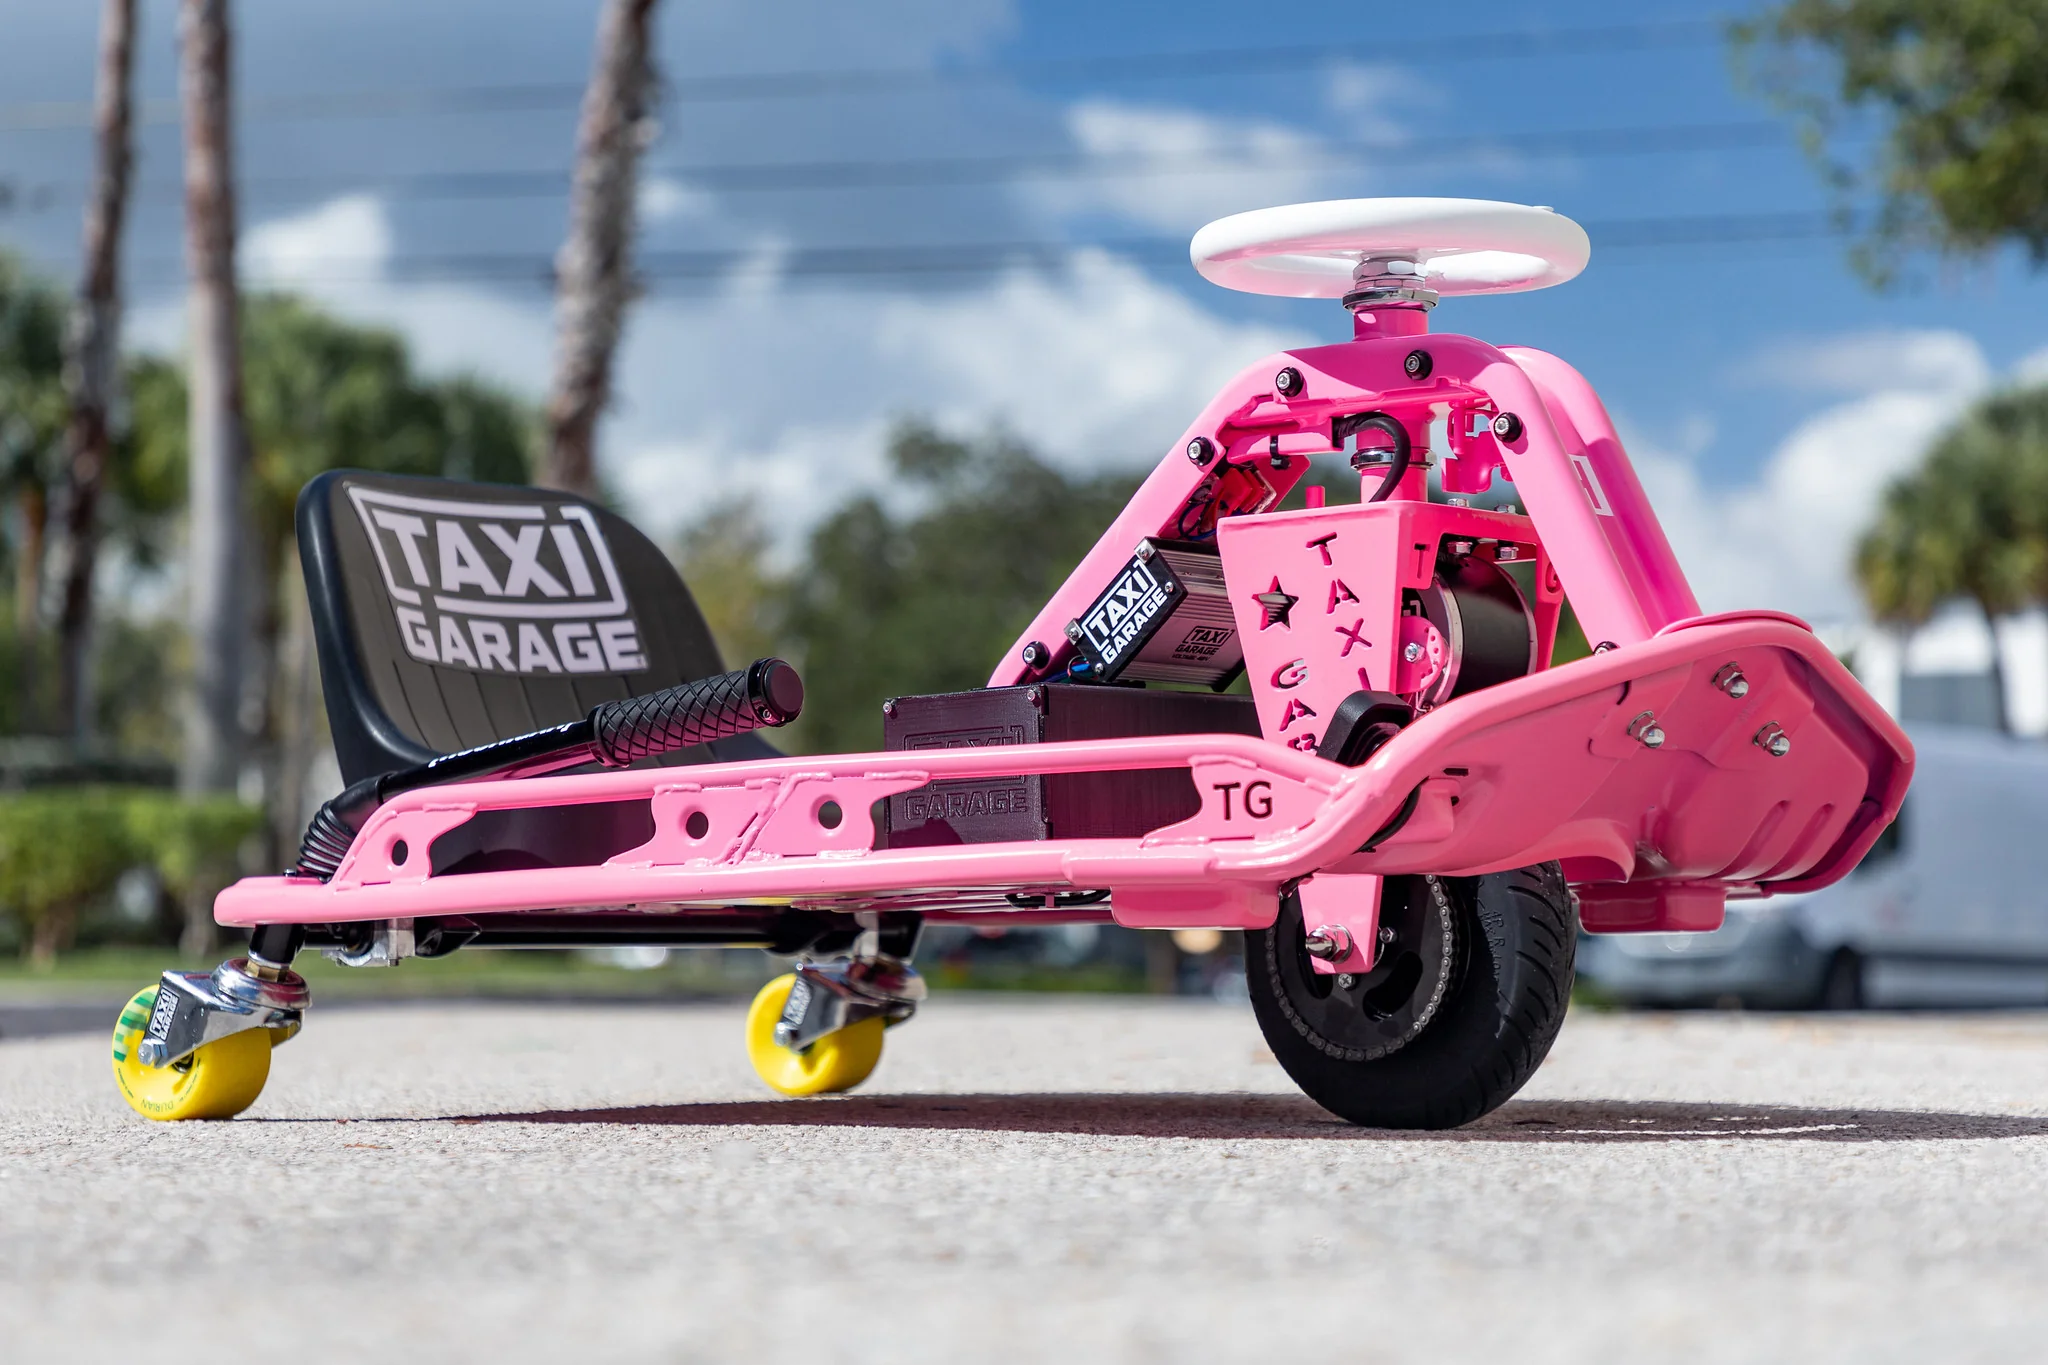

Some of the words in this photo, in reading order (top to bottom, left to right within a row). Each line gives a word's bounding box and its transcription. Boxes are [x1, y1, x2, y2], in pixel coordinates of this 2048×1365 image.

[372, 507, 596, 598] TAXI
[1089, 570, 1149, 637] TAXI
[396, 606, 648, 673] GARAGE
[1101, 587, 1168, 664] GARAGE
[1190, 629, 1229, 644] TAXI
[1175, 644, 1219, 656] GARAGE
[906, 788, 1027, 821] GARAGE
[1213, 780, 1273, 821] TG
[153, 994, 170, 1031] TAXI
[140, 1098, 174, 1113] DURIAN
